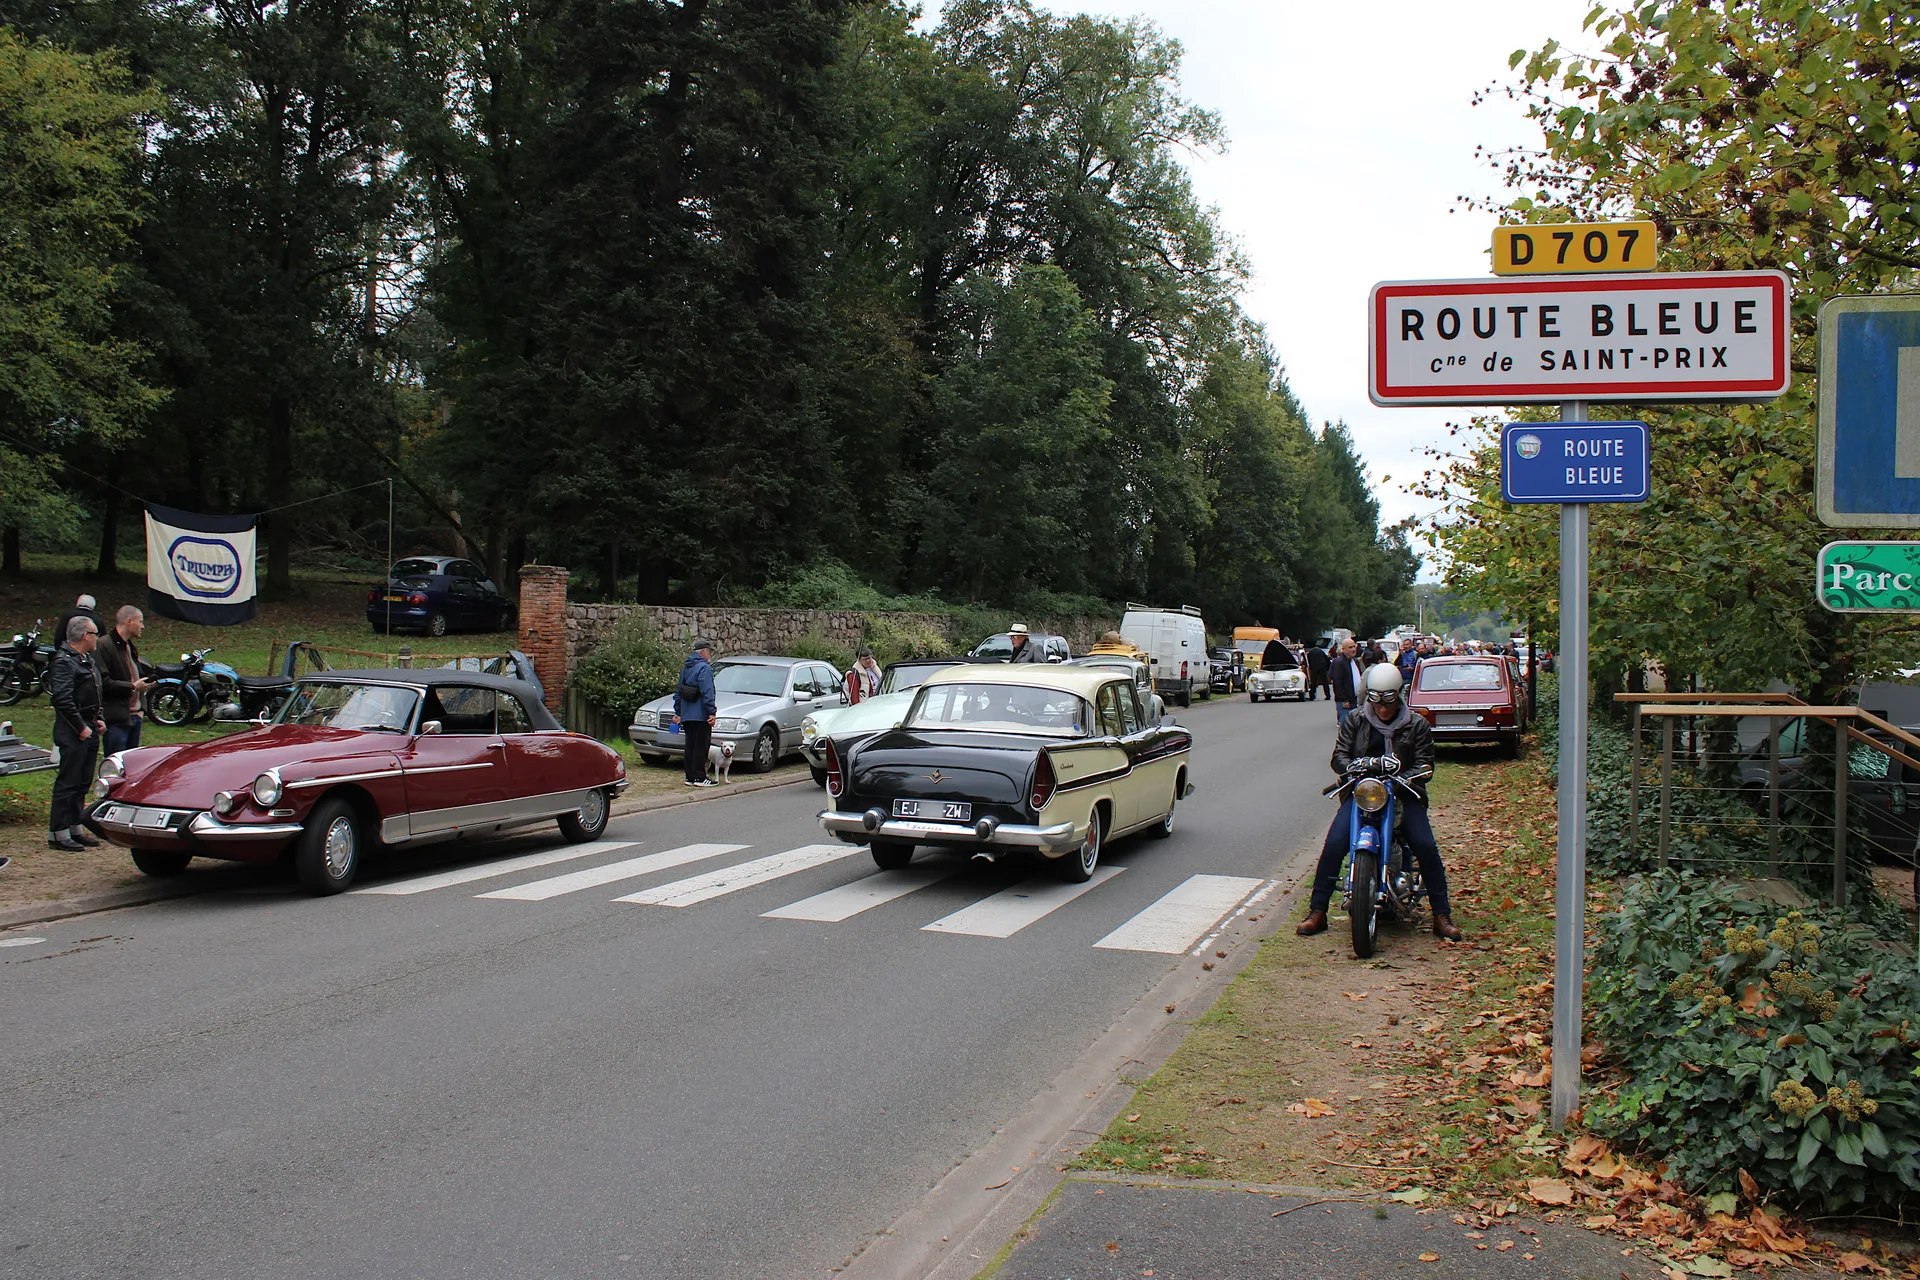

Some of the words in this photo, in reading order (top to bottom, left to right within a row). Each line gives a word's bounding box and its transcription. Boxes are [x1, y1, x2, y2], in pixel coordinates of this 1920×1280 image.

[1510, 234, 1535, 265] D
[1552, 229, 1640, 264] 707
[1401, 305, 1562, 341] ROUTE
[1591, 300, 1758, 337] BLEUE
[1483, 351, 1514, 373] de
[1540, 346, 1729, 371] SAINT-PRIX
[1564, 439, 1624, 457] ROUTE
[1565, 467, 1623, 485] BLEUE
[176, 554, 235, 582] TRIUMPH
[1829, 563, 1913, 591] Parc
